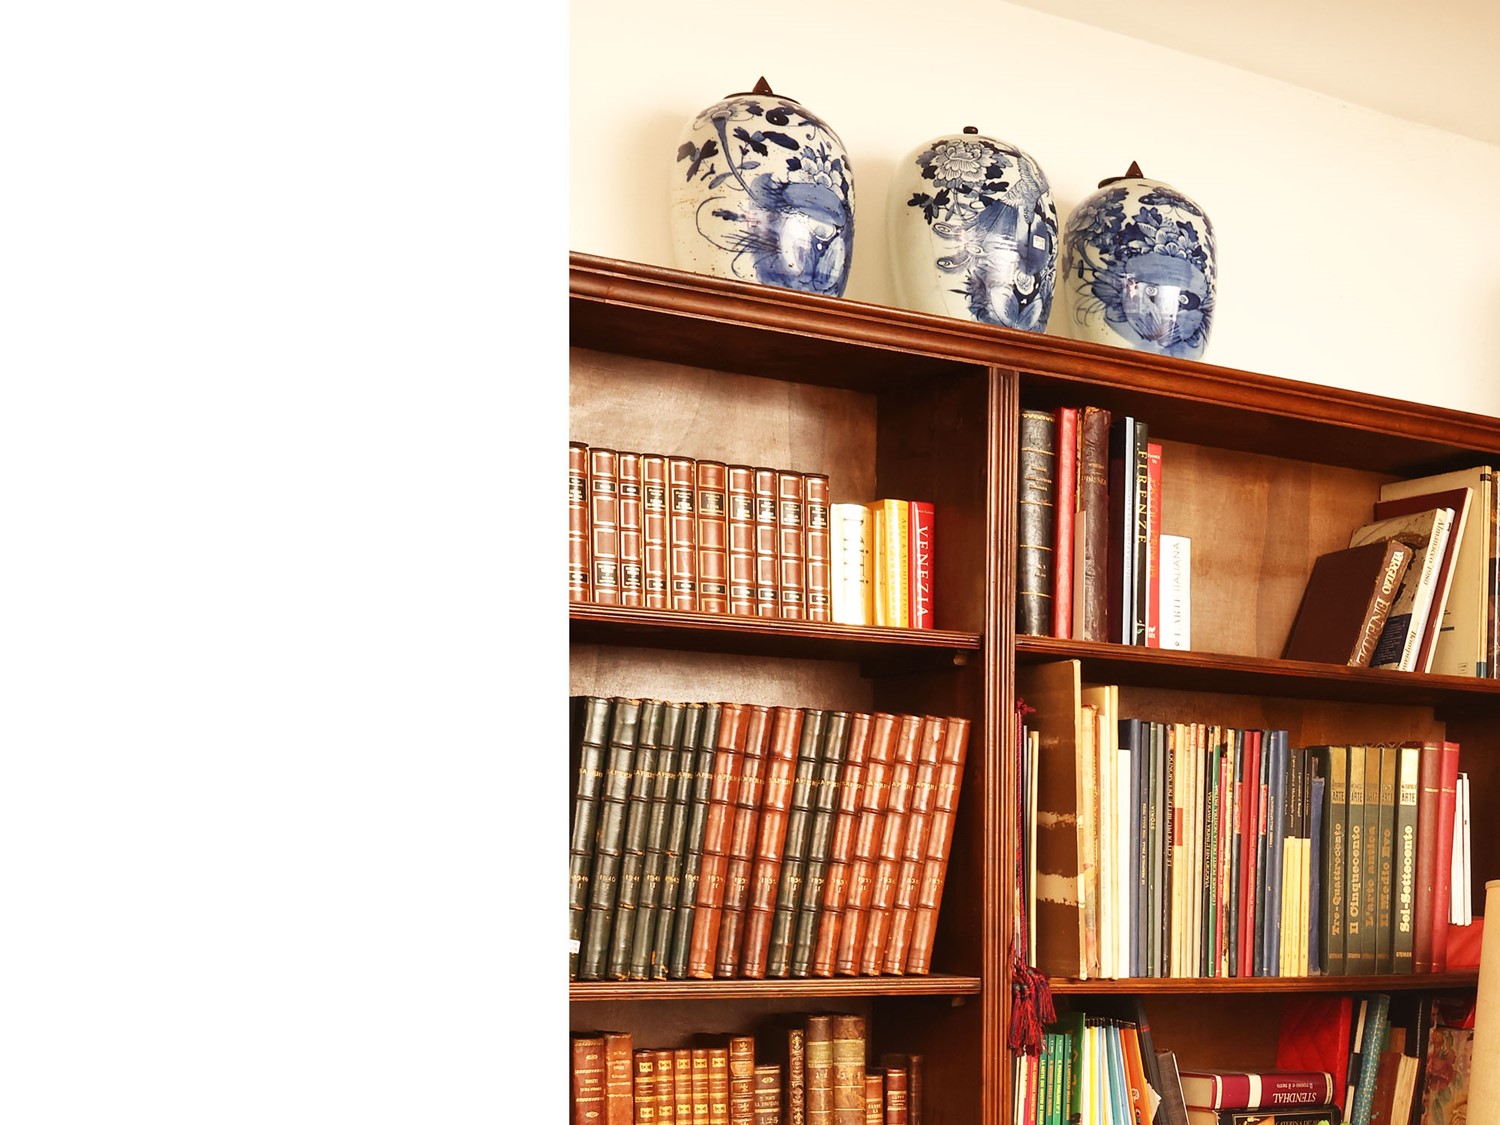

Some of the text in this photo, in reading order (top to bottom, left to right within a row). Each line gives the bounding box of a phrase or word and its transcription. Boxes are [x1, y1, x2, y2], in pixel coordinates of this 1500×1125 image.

[1137, 450, 1148, 544] FIRENZE
[918, 526, 929, 617] VENEZIA
[1356, 551, 1404, 666] VIRGILIO ENEIDE
[1351, 792, 1363, 803] ARTE
[1401, 792, 1415, 803] ARTE
[1331, 823, 1343, 936] Tre-Quattrocento
[1349, 824, 1361, 918] Cinquecento
[1399, 824, 1413, 933] Sei-Settecento
[1272, 1092, 1317, 1104] STENDHAL
